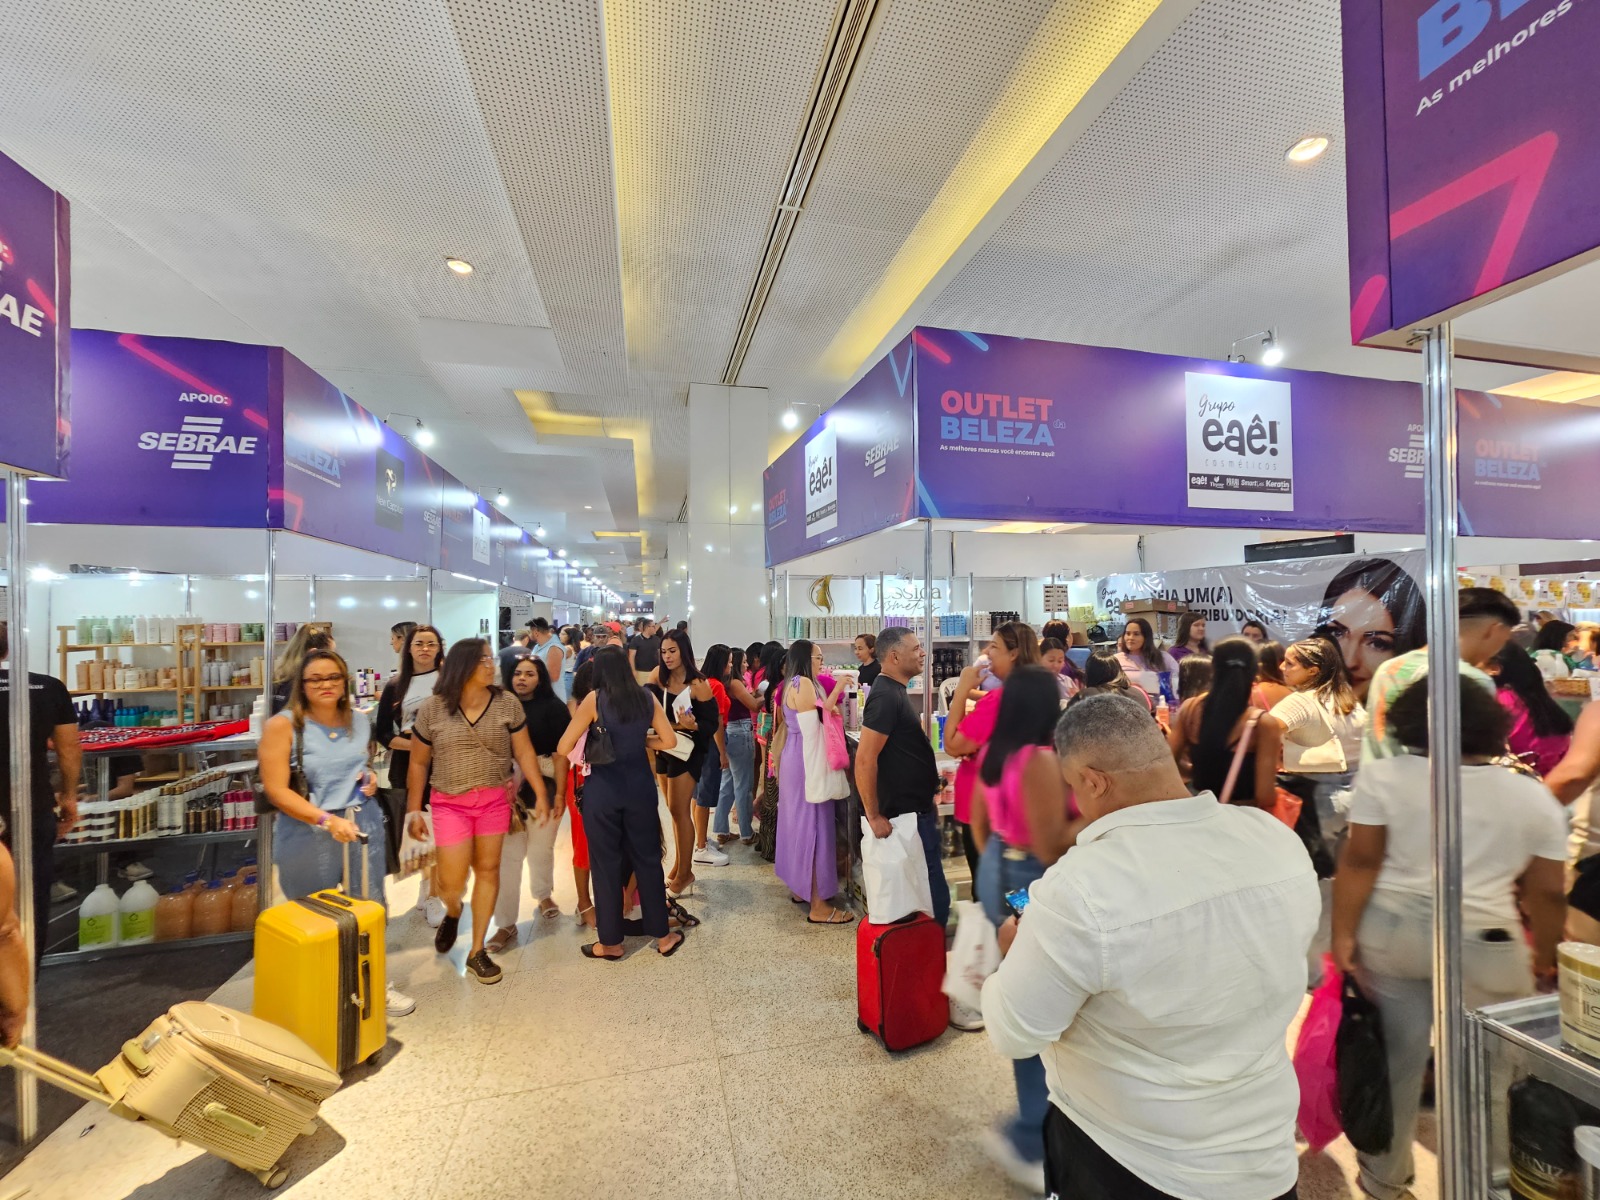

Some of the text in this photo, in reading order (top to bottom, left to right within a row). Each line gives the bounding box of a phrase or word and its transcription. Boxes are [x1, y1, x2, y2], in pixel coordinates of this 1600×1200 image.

[1416, 0, 1573, 117] As melhores
[0, 293, 45, 337] AE
[179, 392, 229, 405] APOIO:
[941, 390, 1053, 421] OUTLET
[941, 416, 1055, 446] BELEZA
[1202, 413, 1279, 457] eaê!
[1407, 424, 1425, 433] APOI
[138, 431, 258, 455] SEBRAE
[949, 445, 977, 453] melhores
[1388, 448, 1425, 463] SEBR
[1474, 459, 1541, 481] BELEZA
[1184, 586, 1233, 605] UM(A)
